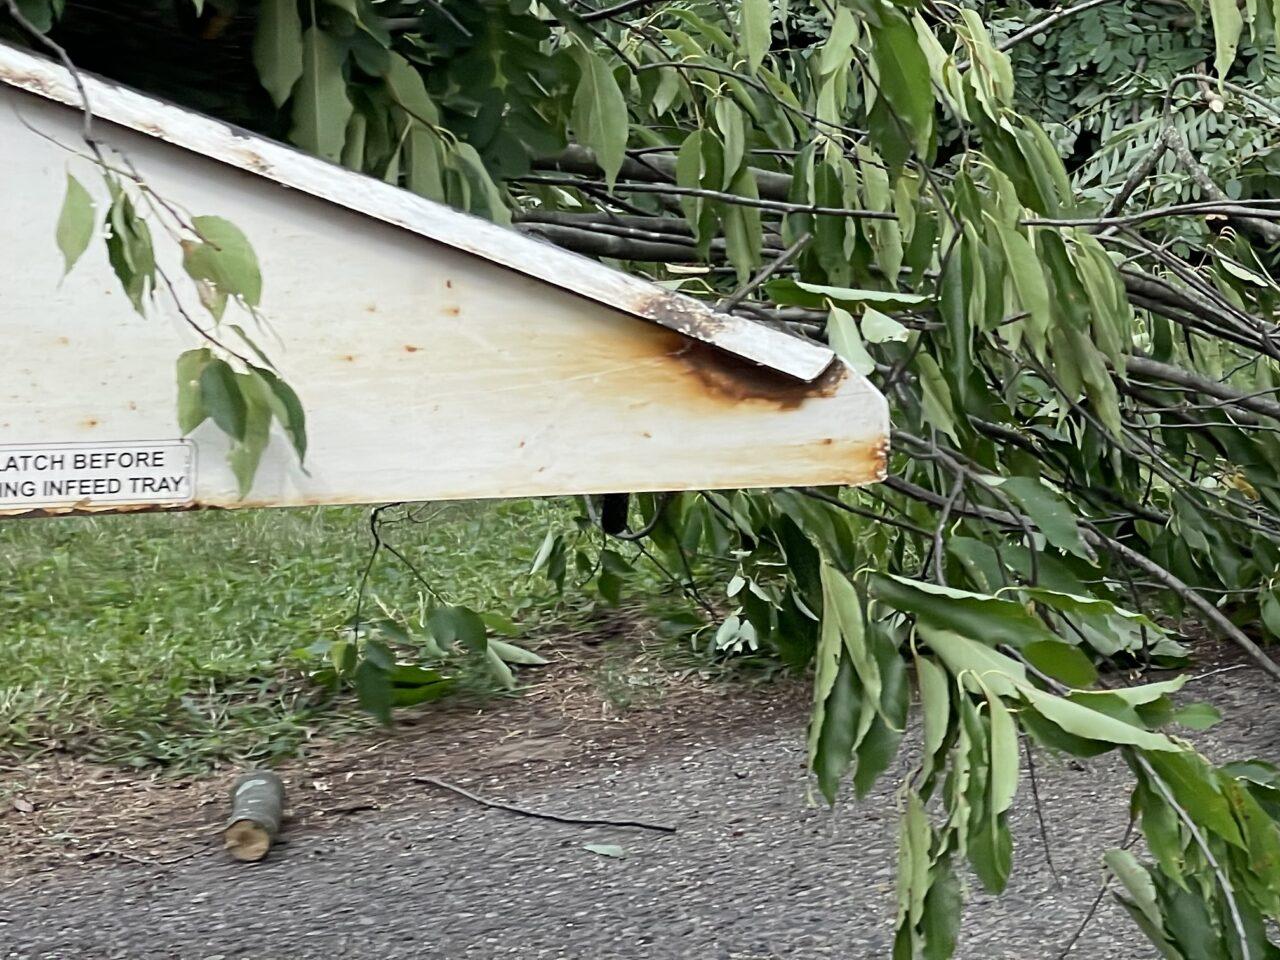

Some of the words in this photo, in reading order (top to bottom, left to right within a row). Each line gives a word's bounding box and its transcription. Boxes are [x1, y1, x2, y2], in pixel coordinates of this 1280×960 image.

[73, 451, 165, 470] BEFORE
[43, 478, 122, 496] INFEED
[129, 476, 185, 494] TRAY
